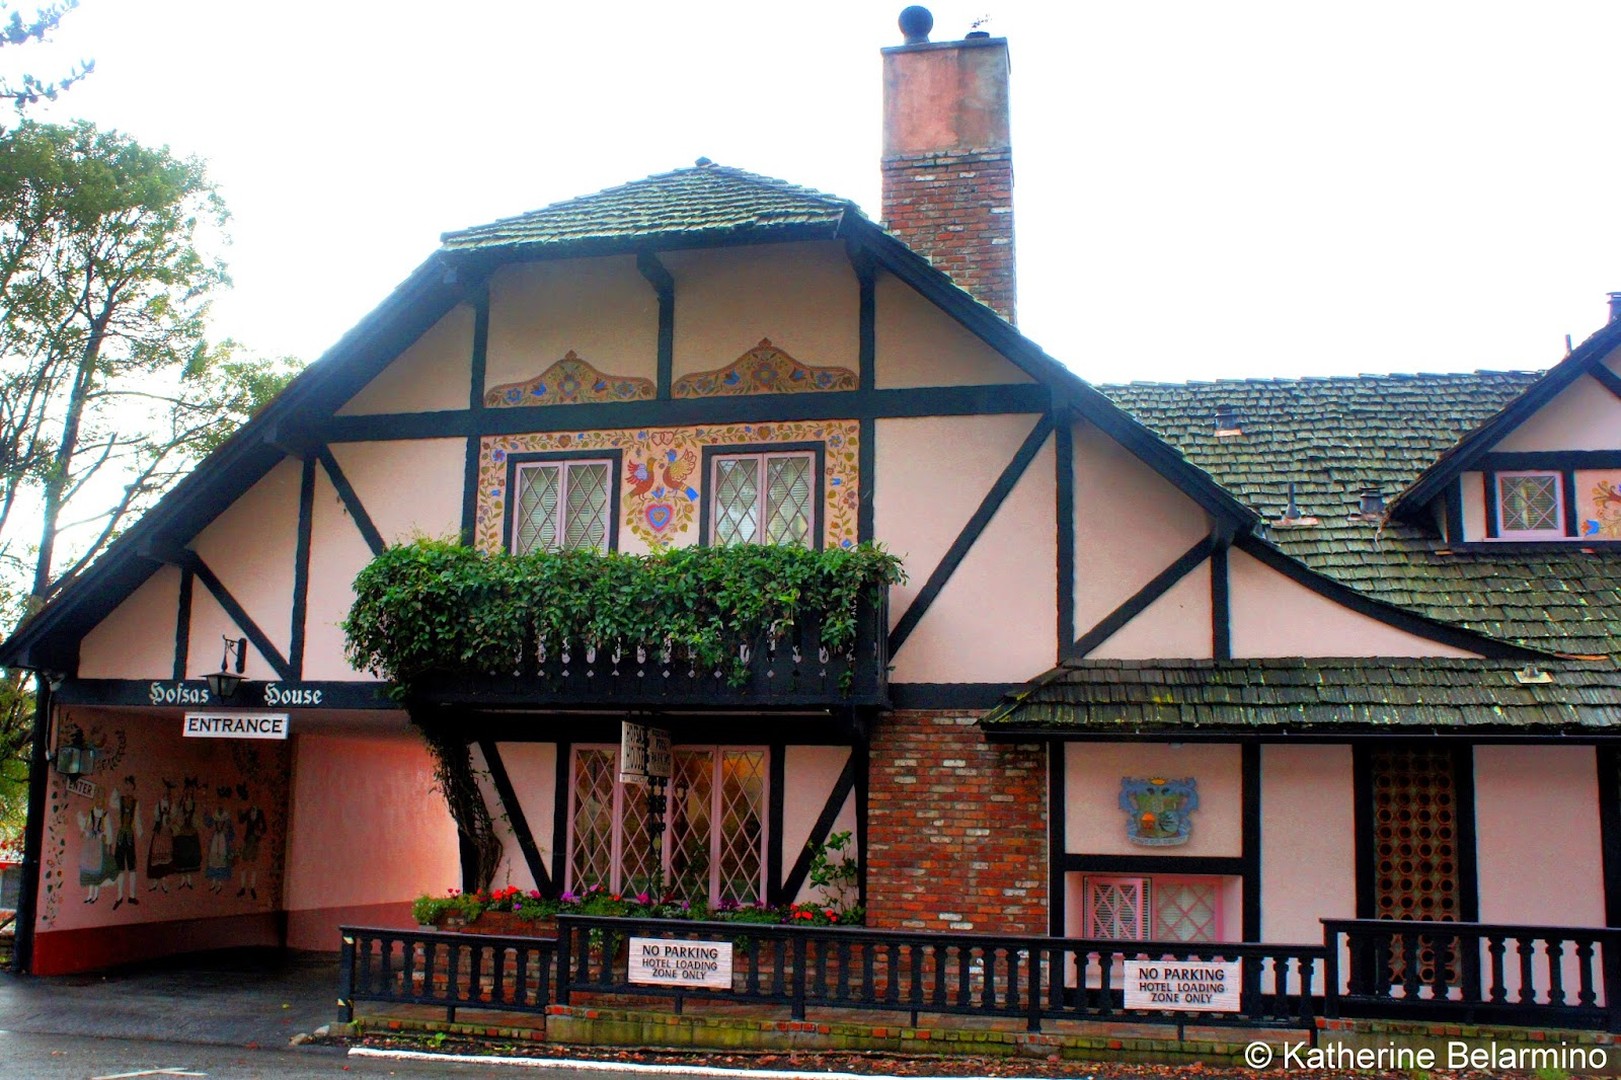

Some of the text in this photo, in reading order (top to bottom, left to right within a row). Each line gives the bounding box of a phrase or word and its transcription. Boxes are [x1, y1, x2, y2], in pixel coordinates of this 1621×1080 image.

[263, 682, 323, 707] House
[187, 717, 284, 734] ENTRANCE
[68, 780, 93, 796] ENTER
[642, 945, 719, 960] NO PARKING
[642, 958, 718, 971] HOTEL LOADING
[652, 968, 707, 980] ZONE ONLY
[1139, 968, 1225, 981] NO PARKING
[1139, 982, 1225, 993] HOTEL LOADING
[1151, 993, 1213, 1004] ZONE ONLY
